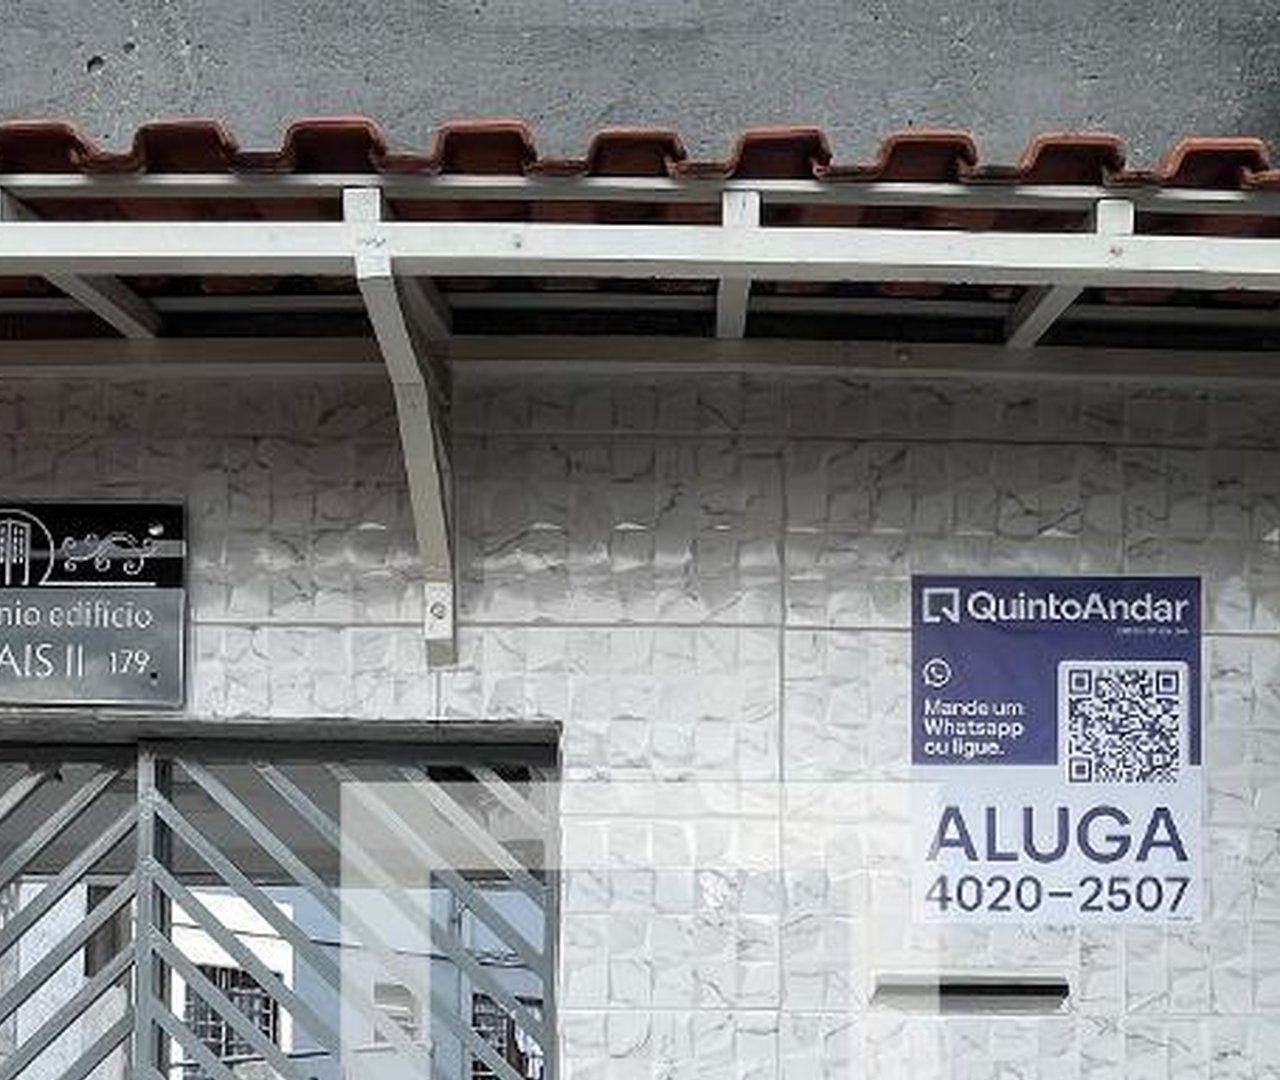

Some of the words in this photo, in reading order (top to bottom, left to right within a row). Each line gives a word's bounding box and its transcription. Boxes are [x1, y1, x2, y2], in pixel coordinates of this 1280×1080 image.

[967, 591, 1190, 622] QuintoAndar
[66, 642, 84, 678] II
[108, 649, 151, 675] 179
[924, 698, 989, 716] Mande
[992, 702, 1024, 716] um
[924, 718, 1024, 740] Whatsapp
[924, 741, 949, 756] ou
[952, 737, 1006, 760] ligue.
[926, 805, 1189, 864] ALUGA
[925, 874, 1191, 913] 4020-2507
